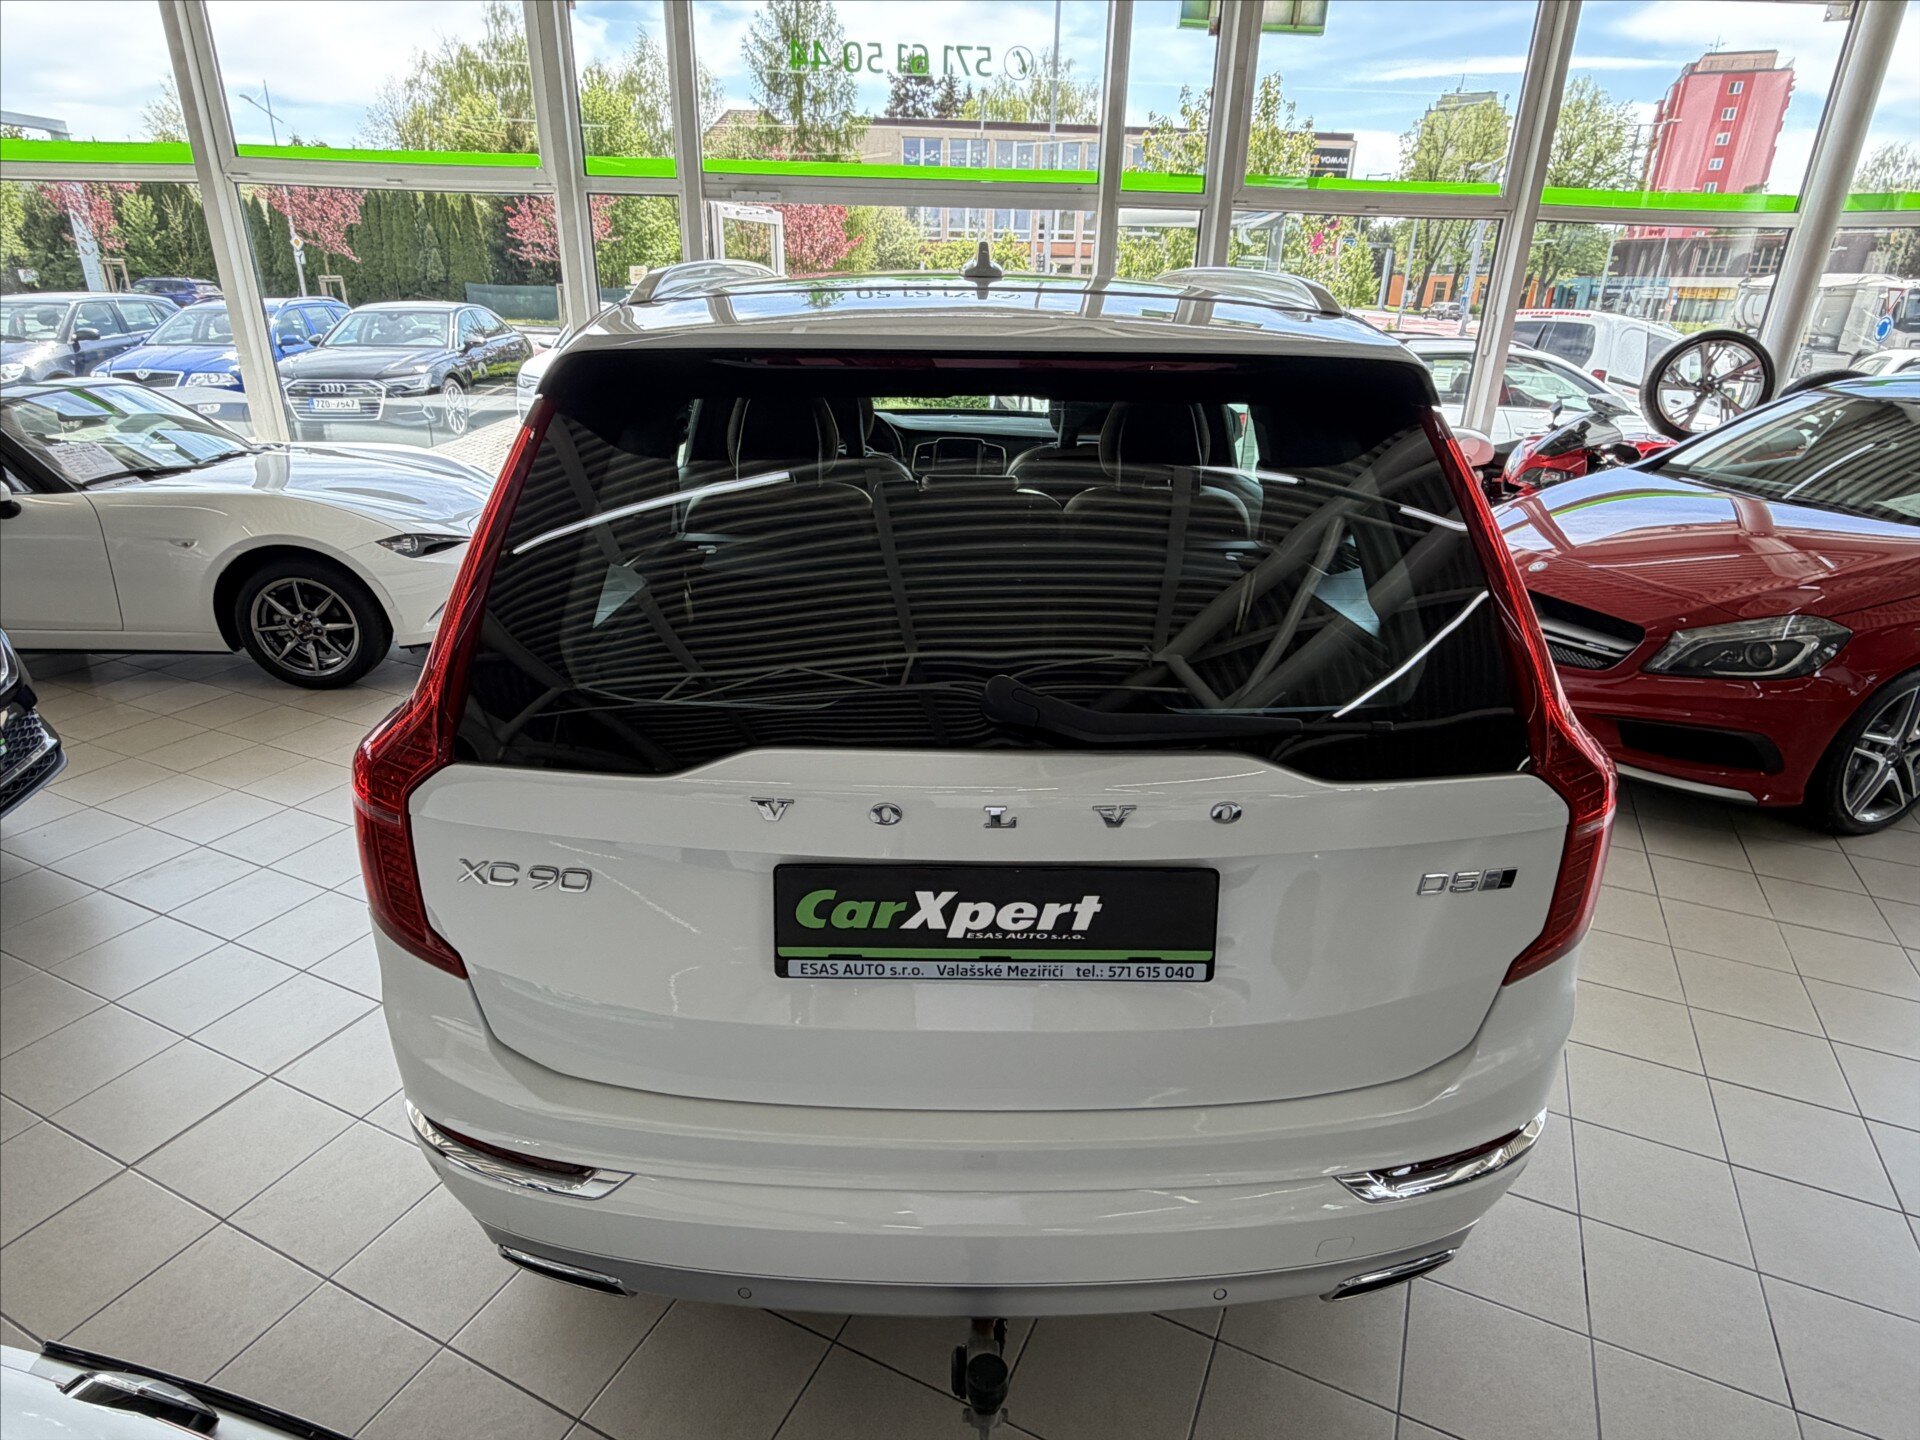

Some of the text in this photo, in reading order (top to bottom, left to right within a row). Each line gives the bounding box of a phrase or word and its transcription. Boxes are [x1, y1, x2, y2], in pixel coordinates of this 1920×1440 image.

[1320, 155, 1348, 165] YOMAX
[750, 797, 1242, 828] VOLVO
[1416, 871, 1480, 895] D5
[795, 889, 1103, 939] CarXpert
[1008, 932, 1048, 940] AUTO
[800, 962, 1195, 979] ESAS AUTO s.r.o. Valašské Meziříčí tel.: 571 615 040
